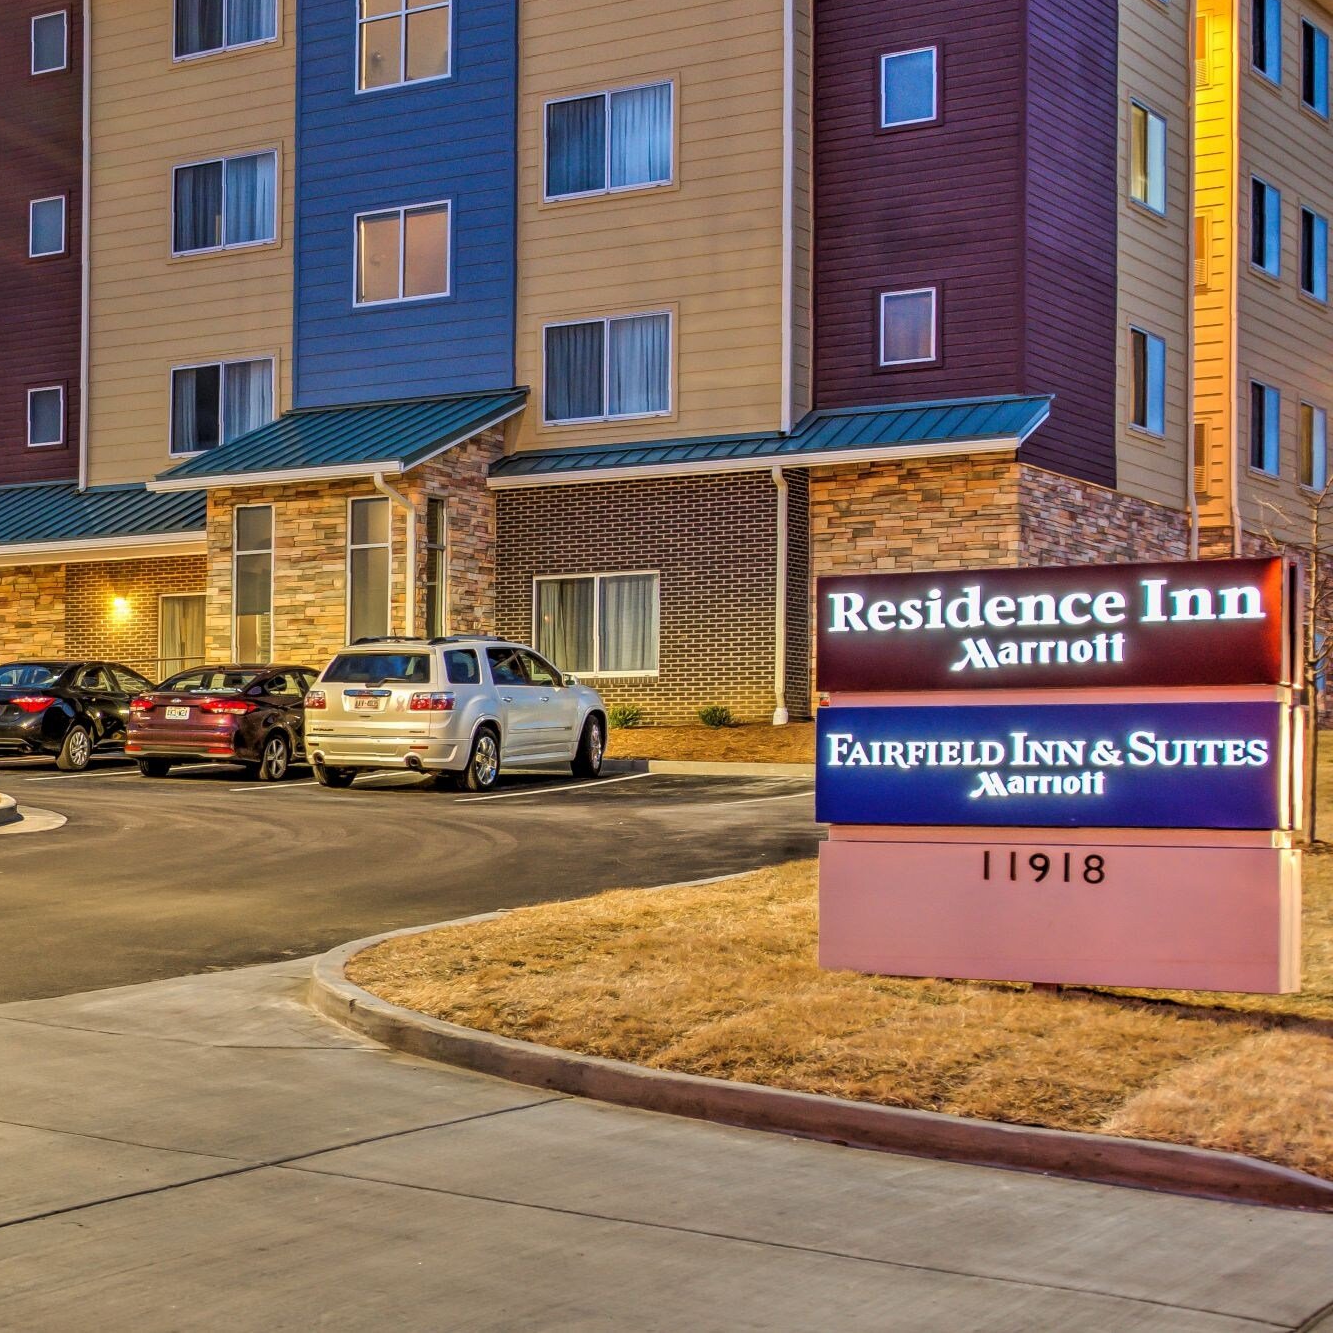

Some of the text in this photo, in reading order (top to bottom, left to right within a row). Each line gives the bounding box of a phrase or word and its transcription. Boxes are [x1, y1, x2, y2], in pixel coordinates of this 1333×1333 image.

[827, 578, 1267, 633] Residence Inn
[949, 632, 1127, 672] Marriott
[826, 729, 1270, 769] FAIRFIELD INN & SUITES
[969, 771, 1106, 799] Marriott
[982, 850, 1107, 885] 11918
